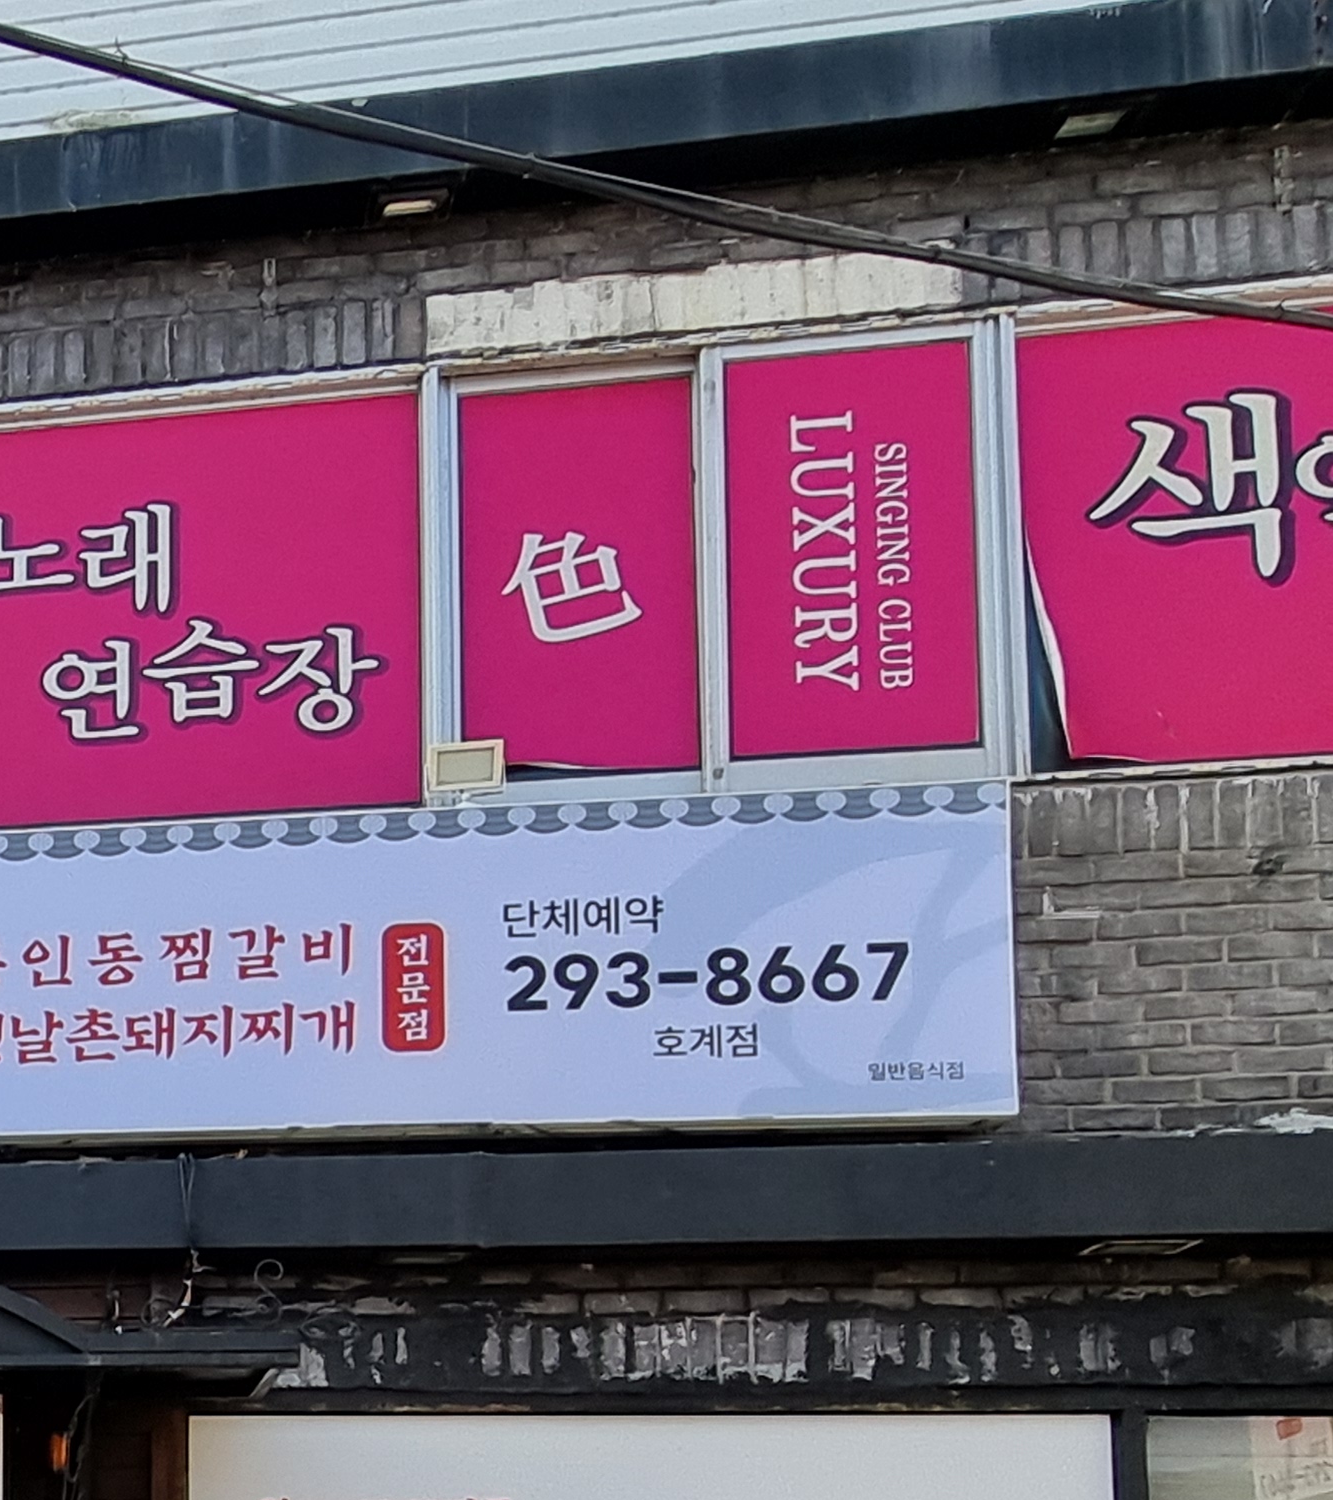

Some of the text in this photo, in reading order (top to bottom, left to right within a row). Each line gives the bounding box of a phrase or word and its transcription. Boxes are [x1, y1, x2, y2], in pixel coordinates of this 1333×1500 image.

[501, 531, 643, 645] 色
[789, 410, 860, 692] LUXURY
[874, 442, 914, 690] SINGING CLUB
[41, 621, 380, 741] 연습장
[501, 895, 664, 939] 단체예약
[395, 933, 432, 1042] 전문점
[504, 942, 910, 1012] 293-8667
[652, 1022, 760, 1059] 호계점
[868, 1061, 965, 1081] 일반음식점
